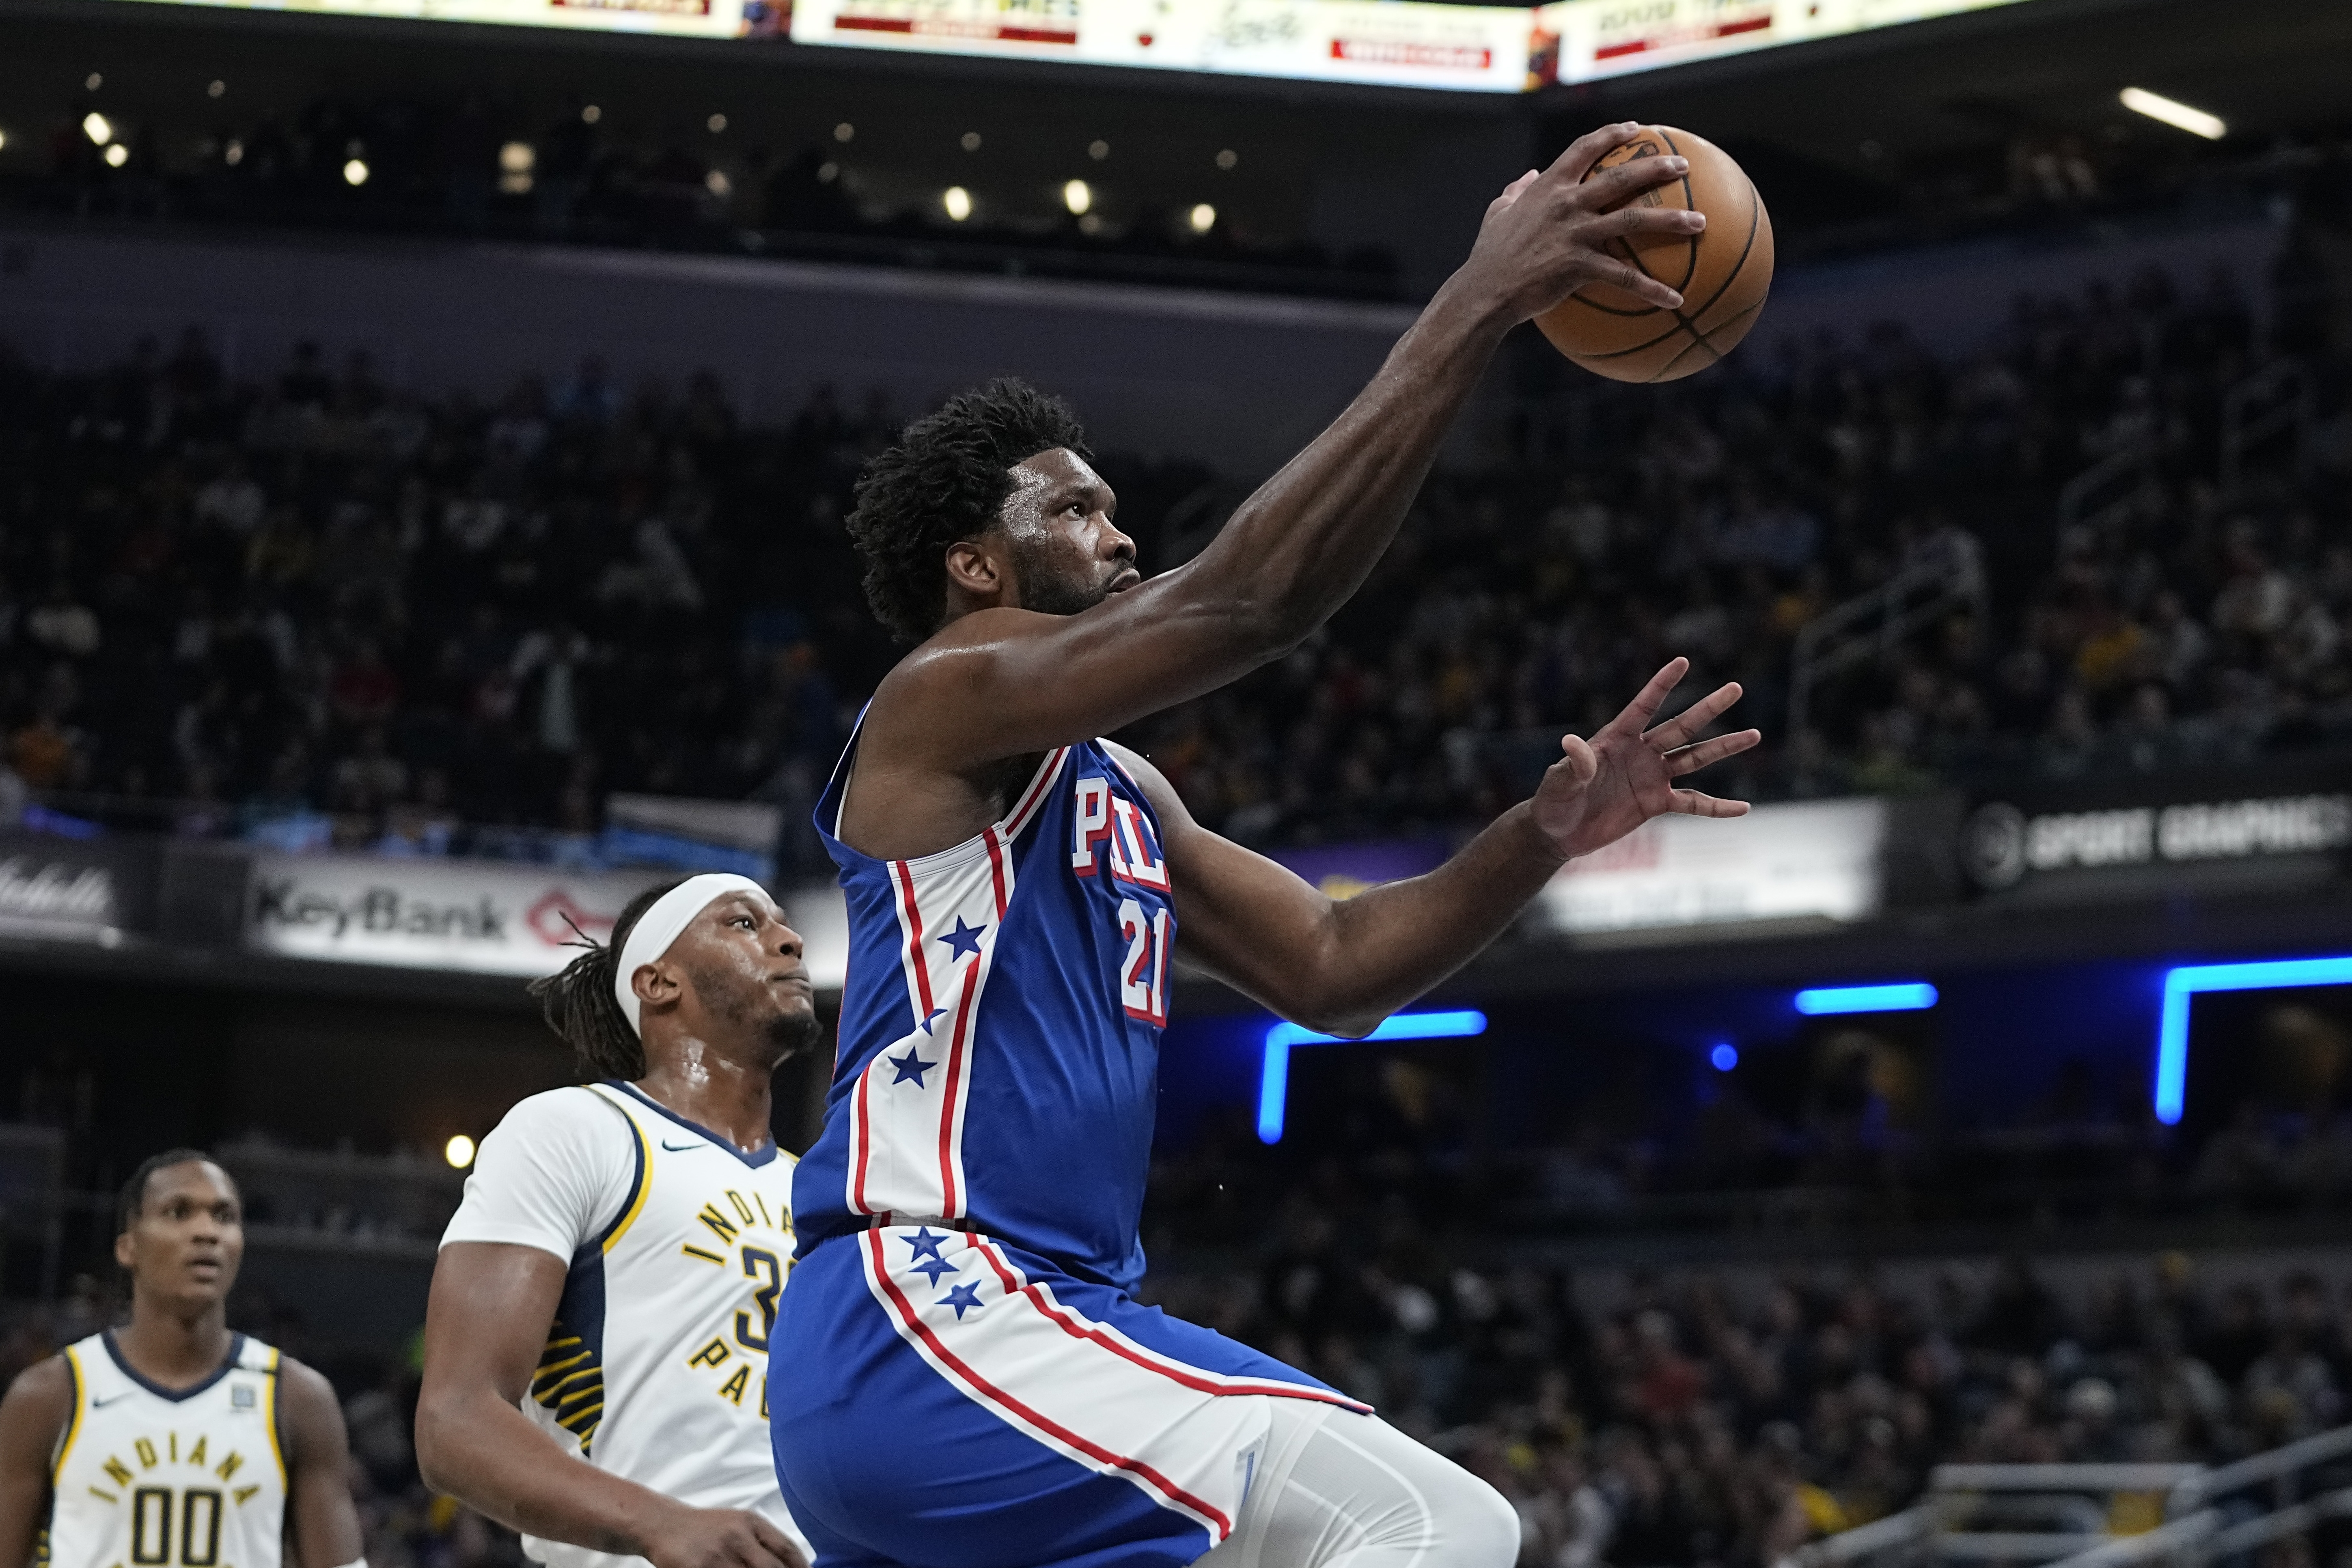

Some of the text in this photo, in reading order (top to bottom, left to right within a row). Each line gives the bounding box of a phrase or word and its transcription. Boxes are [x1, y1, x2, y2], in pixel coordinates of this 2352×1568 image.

[2029, 808, 2152, 869] SPORT
[257, 877, 507, 941] KeyBank
[1119, 898, 1170, 1028] 21
[735, 1245, 798, 1355] 3
[87, 1430, 261, 1507] INDIANA
[132, 1484, 223, 1567] 00
